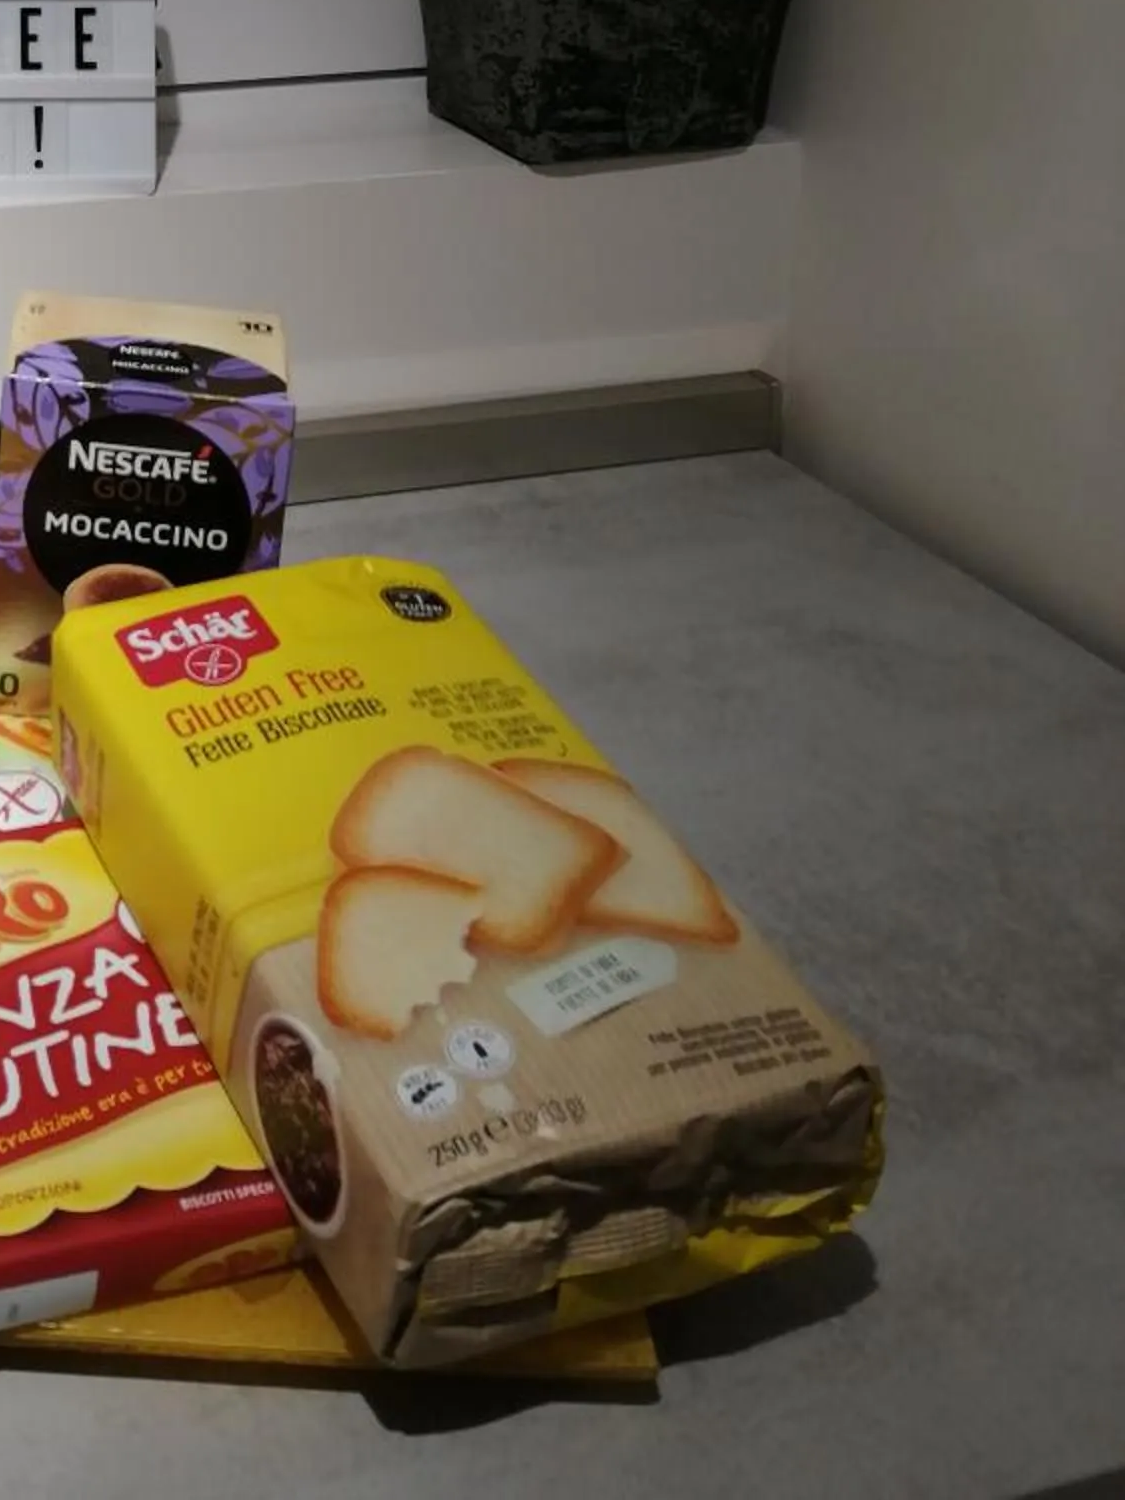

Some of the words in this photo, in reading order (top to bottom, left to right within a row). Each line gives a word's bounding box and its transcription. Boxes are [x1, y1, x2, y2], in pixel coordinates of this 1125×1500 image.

[68, 439, 216, 484] NESCAFÉ
[92, 476, 187, 507] GOLD
[44, 510, 228, 552] MOCACCINO
[126, 606, 257, 663] Schär
[165, 683, 284, 739] Gluten
[285, 664, 365, 699] Free
[183, 727, 254, 769] Fette
[256, 695, 388, 745] Biscottate
[154, 1064, 187, 1092] per
[427, 1134, 470, 1168] 250
[179, 1188, 235, 1212] BISCOTTI
